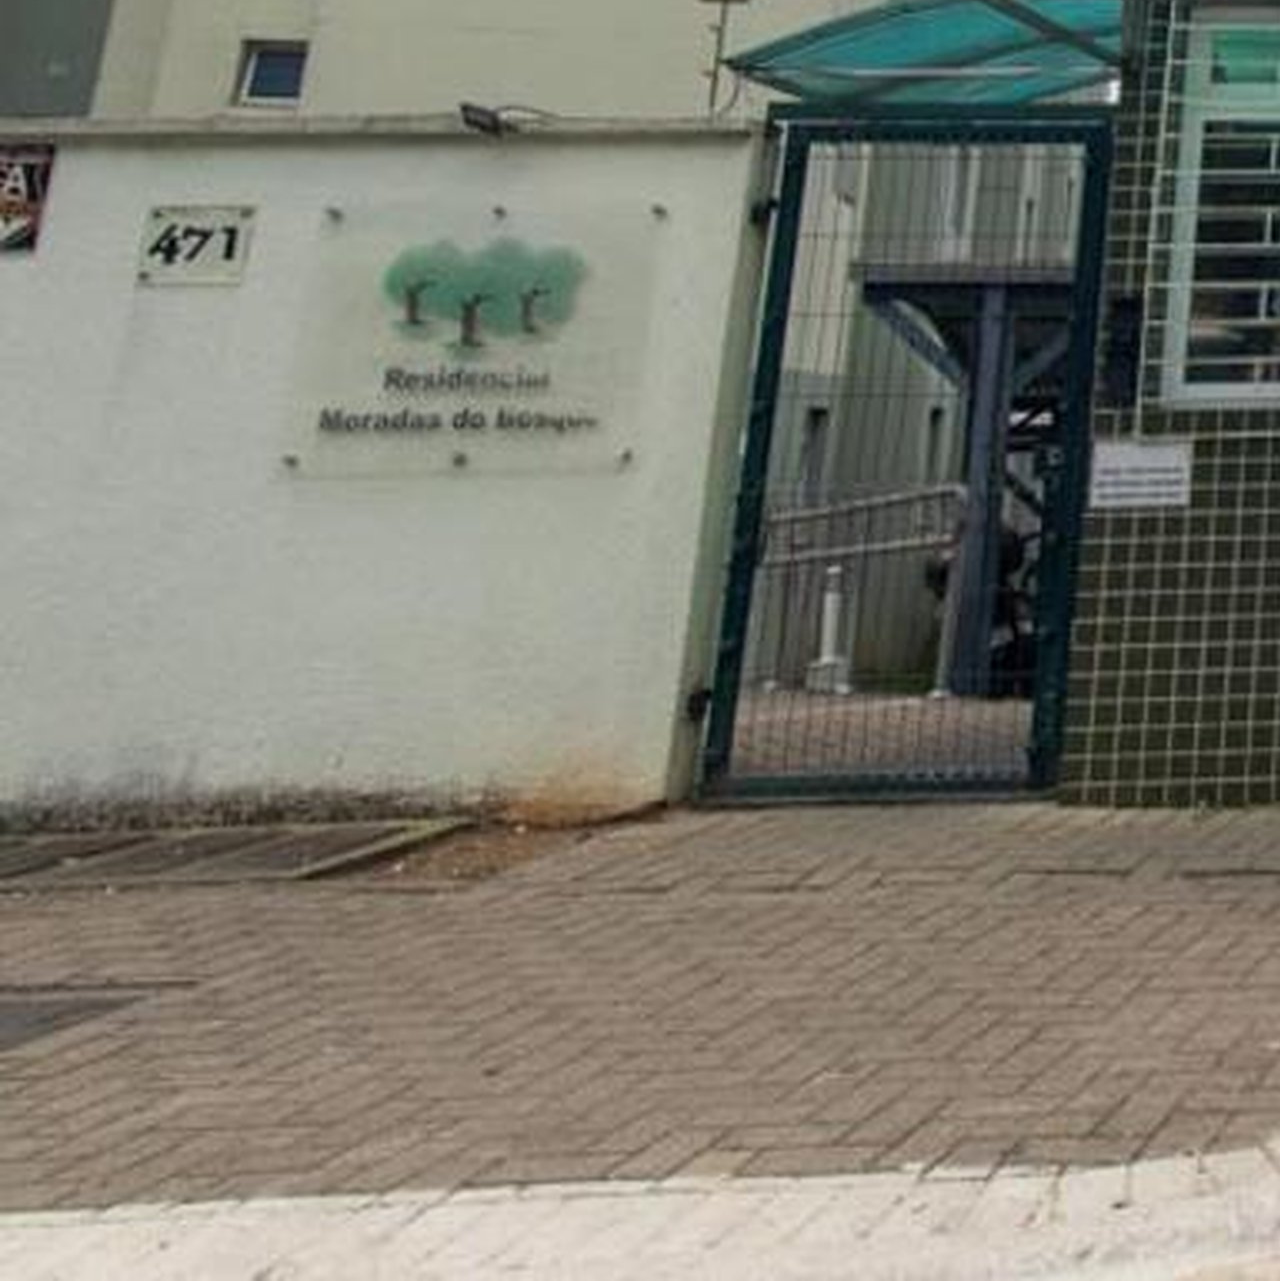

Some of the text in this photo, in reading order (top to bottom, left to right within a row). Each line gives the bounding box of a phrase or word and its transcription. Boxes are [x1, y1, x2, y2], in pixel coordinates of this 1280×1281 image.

[147, 222, 239, 266] 471
[318, 407, 443, 431] Moradas
[452, 407, 487, 430] do
